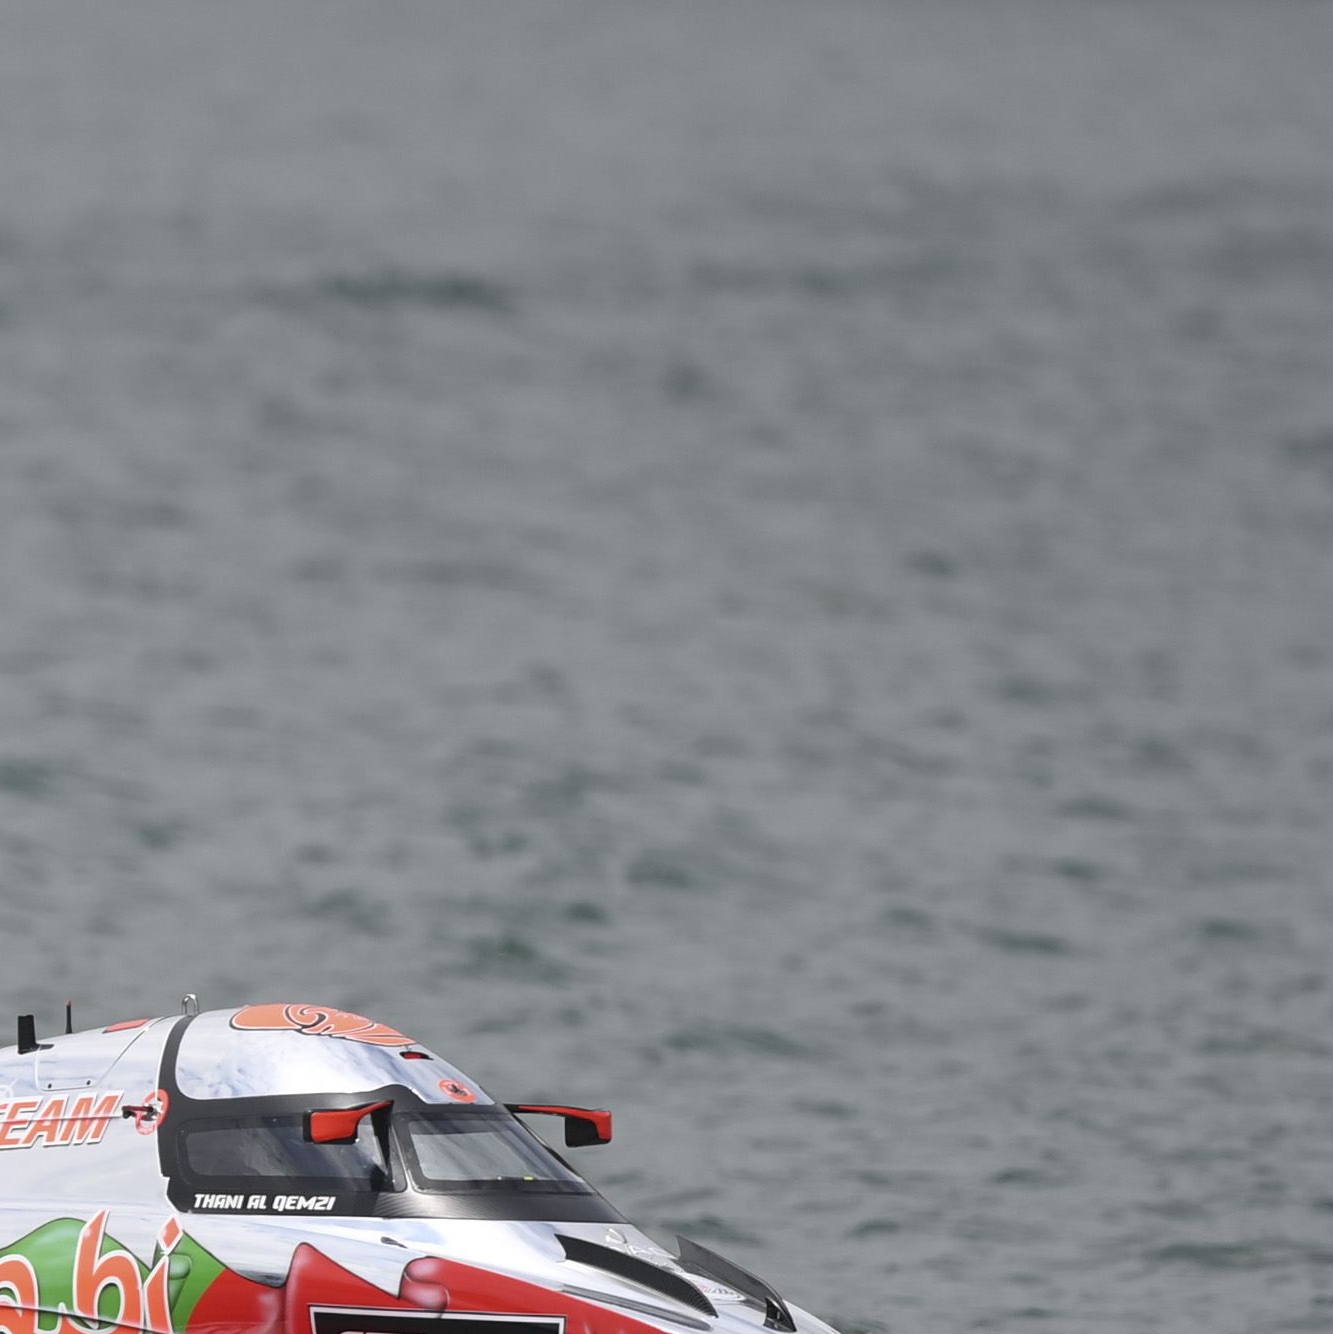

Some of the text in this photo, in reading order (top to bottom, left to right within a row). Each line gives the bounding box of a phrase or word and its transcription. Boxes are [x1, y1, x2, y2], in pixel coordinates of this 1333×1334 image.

[193, 1193, 337, 1212] THANI AL QEMZI
